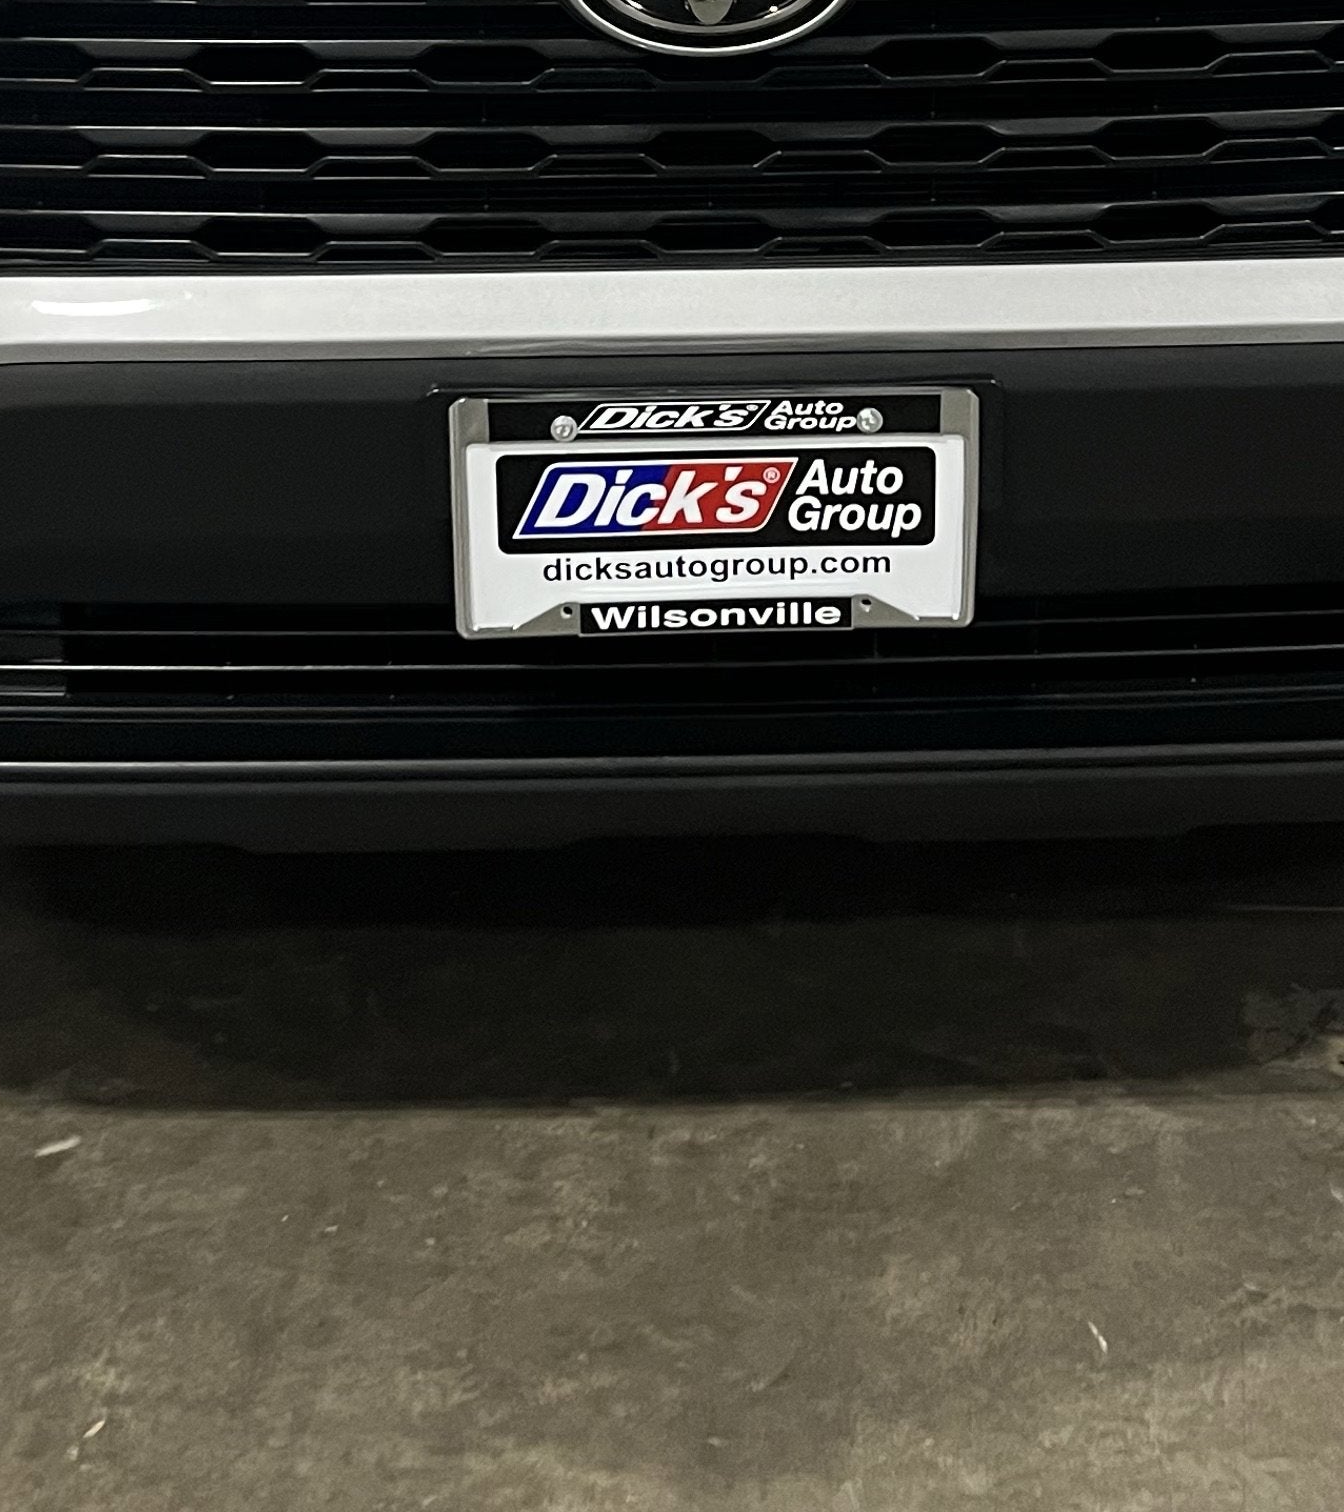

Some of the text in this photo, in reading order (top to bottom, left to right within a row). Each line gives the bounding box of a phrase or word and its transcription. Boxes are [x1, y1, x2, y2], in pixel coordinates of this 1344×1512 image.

[588, 404, 747, 430] Dick's
[764, 412, 856, 432] Group
[772, 400, 844, 416] Auto
[796, 459, 903, 495] Auto
[534, 466, 766, 528] Dick's
[788, 496, 922, 538] Group
[543, 554, 891, 582] dicksautogroup.com
[591, 601, 842, 630] Wilsonville
